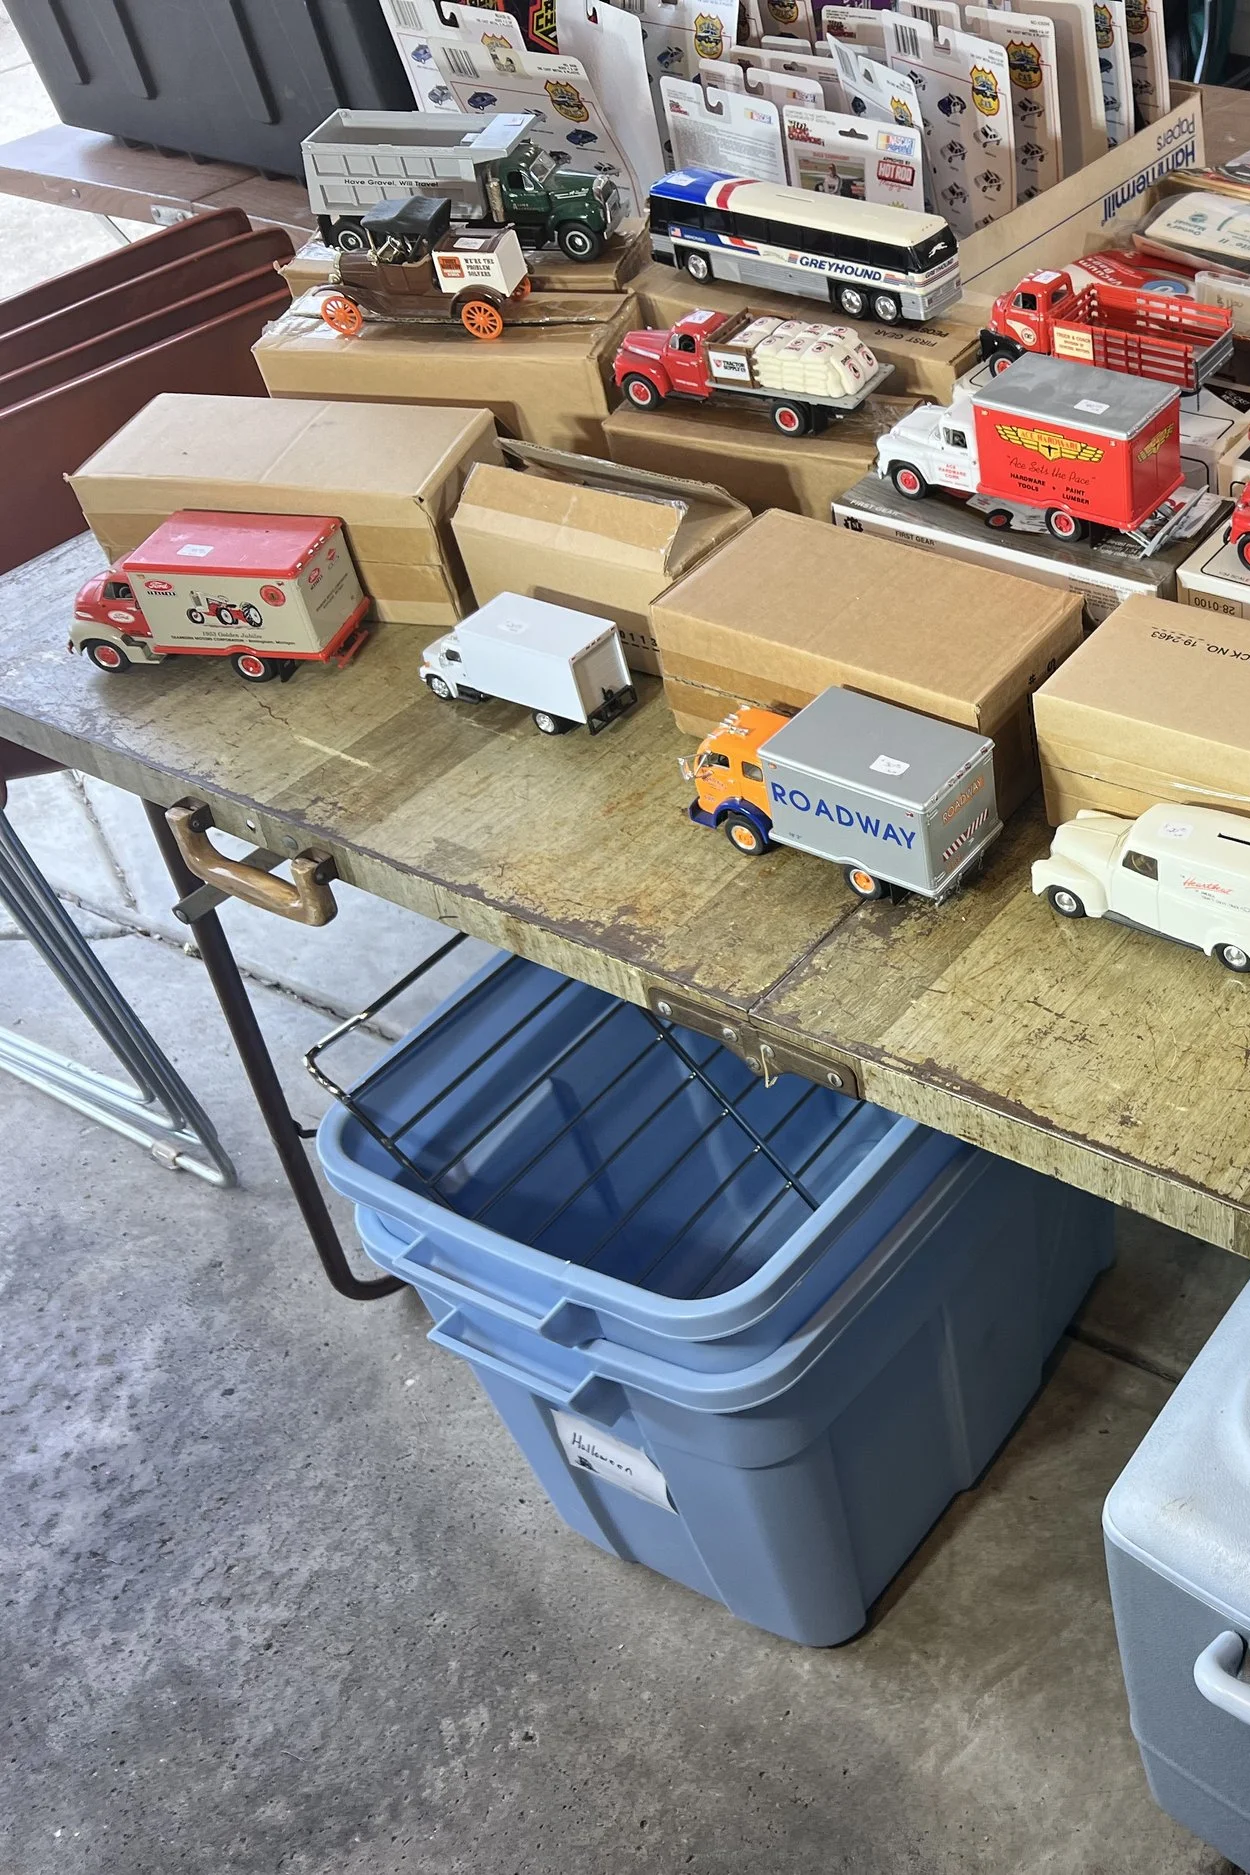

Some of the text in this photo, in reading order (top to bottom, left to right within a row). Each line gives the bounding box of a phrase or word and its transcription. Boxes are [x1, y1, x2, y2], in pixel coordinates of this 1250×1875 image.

[1157, 113, 1195, 151] Papers
[878, 163, 914, 181] HOT ROD
[1103, 141, 1196, 222] Hammermill
[799, 256, 882, 282] GREYHOUND
[874, 328, 937, 348] FIRST GEAR
[1029, 461, 1050, 476] Sets
[1051, 465, 1067, 479] the
[1010, 472, 1046, 487] HARDWARE
[1018, 482, 1040, 493] TOOLS
[1062, 493, 1091, 506] LUMBER
[1065, 486, 1087, 497] PAINT
[850, 499, 873, 512] FIRST
[895, 530, 935, 547] FIRST GEAR
[1150, 630, 1199, 648] 19-2463
[1206, 642, 1231, 656] NO.
[942, 775, 985, 823] ROADWAY
[771, 781, 916, 850] ROADWAY
[571, 1431, 633, 1477] Halloween
